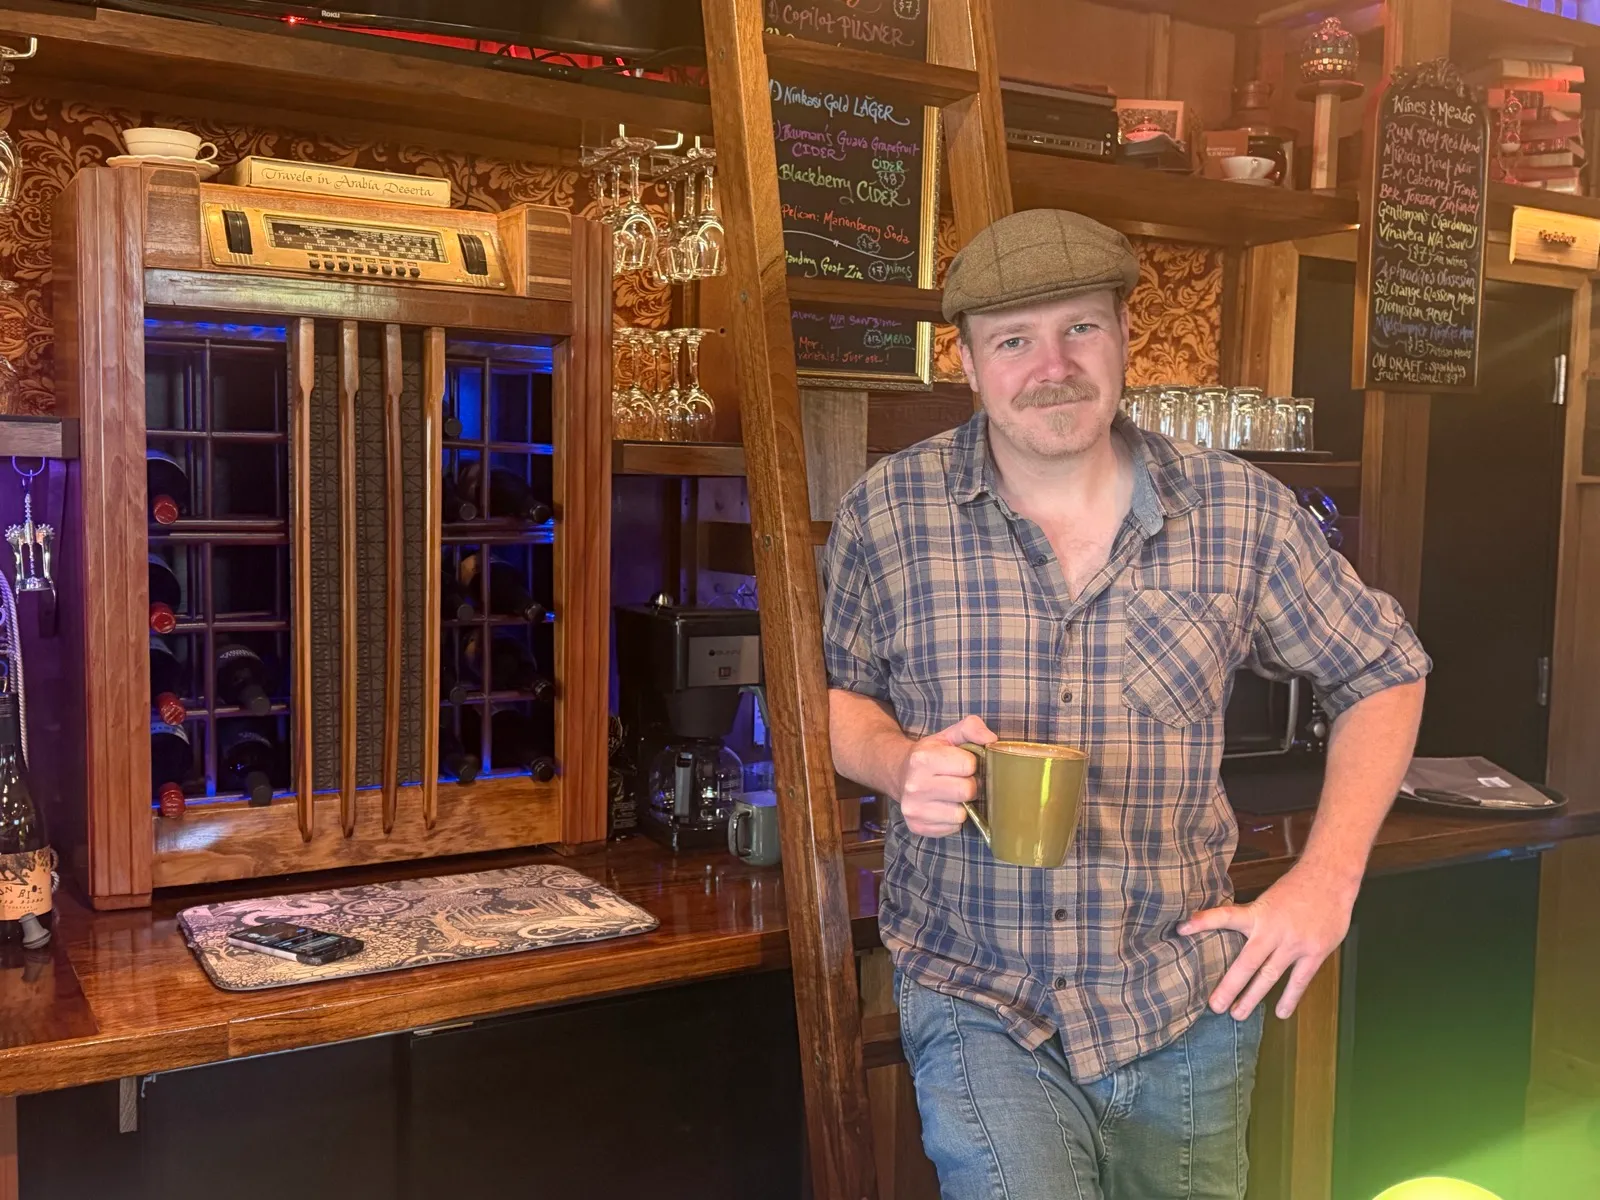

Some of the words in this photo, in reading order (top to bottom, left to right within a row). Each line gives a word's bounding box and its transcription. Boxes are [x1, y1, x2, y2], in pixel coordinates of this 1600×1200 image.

[783, 86, 822, 108] Ninkasi
[824, 93, 849, 118] Gold
[1392, 95, 1427, 115] Wines
[1438, 101, 1476, 127] Meads
[792, 142, 847, 161] CIDER
[837, 130, 868, 152] Guava
[261, 167, 312, 183] Travels
[317, 172, 331, 185] in
[334, 174, 381, 190] Arabia
[383, 181, 434, 198] Deserta
[778, 163, 854, 204] Blackberry
[1407, 168, 1451, 193] Cabernet
[823, 210, 880, 243] Marionberry
[884, 225, 910, 244] Soda
[821, 256, 845, 276] Goat
[844, 265, 864, 280] Zin
